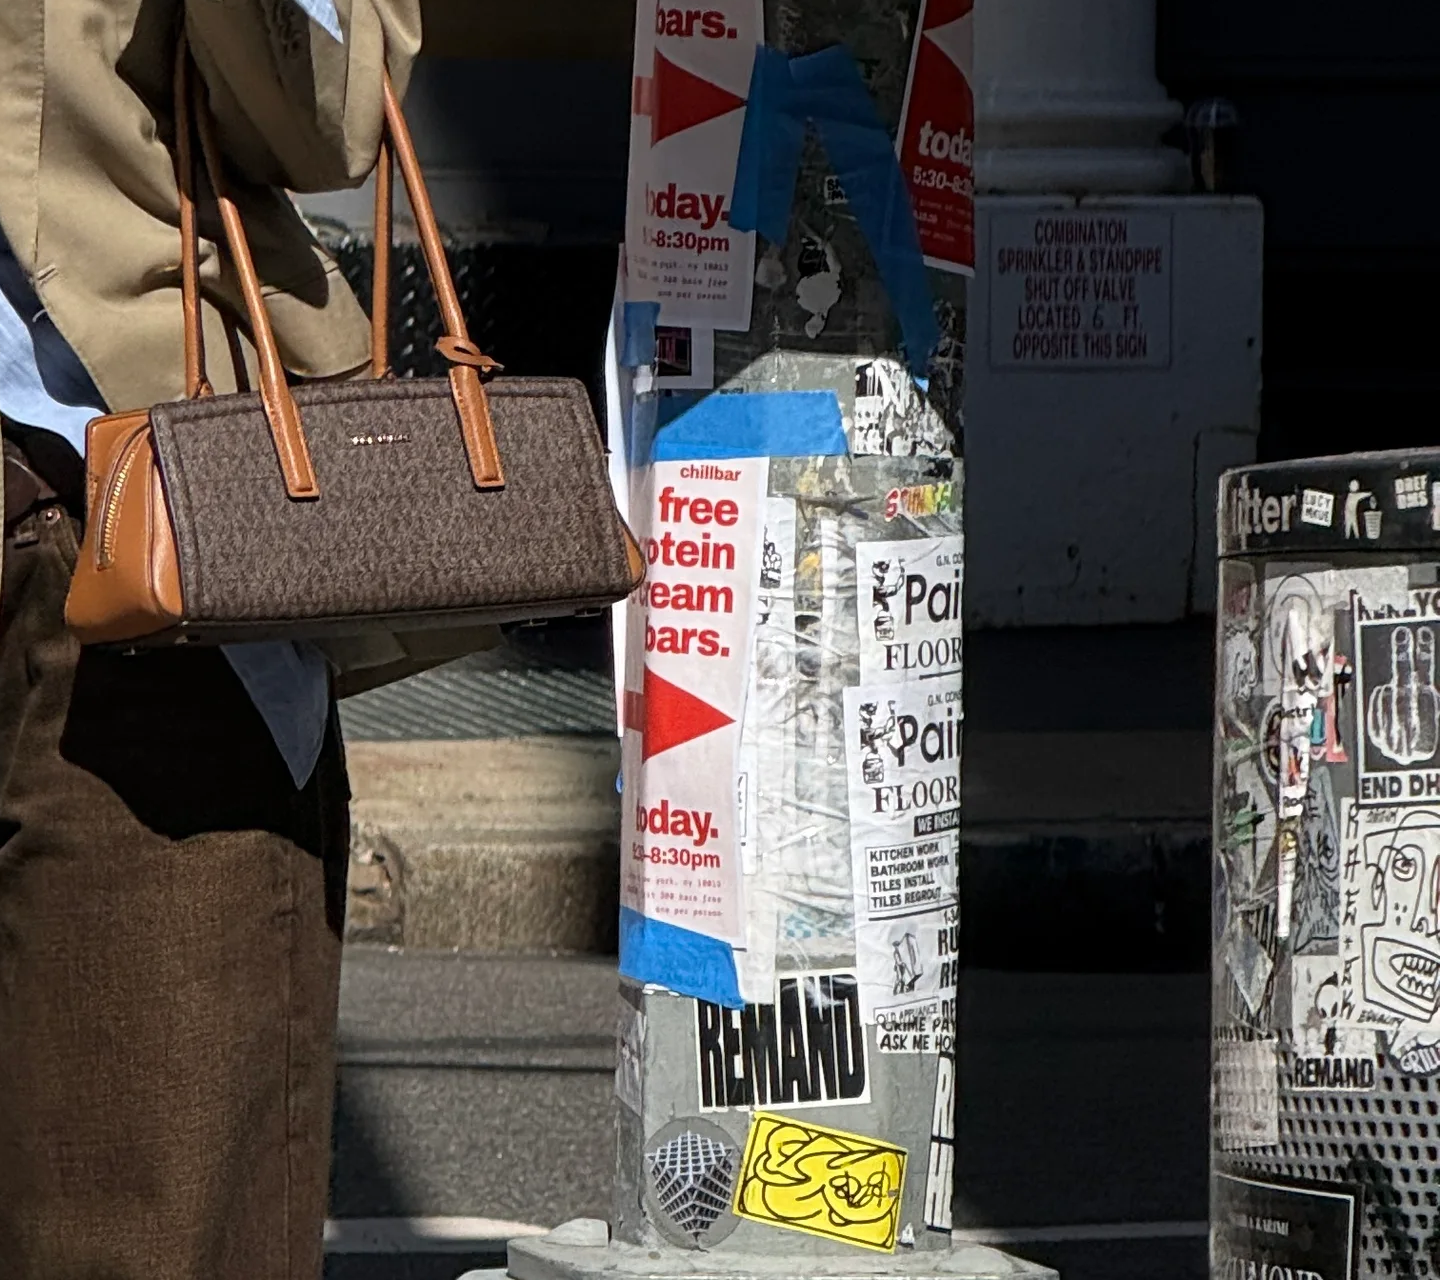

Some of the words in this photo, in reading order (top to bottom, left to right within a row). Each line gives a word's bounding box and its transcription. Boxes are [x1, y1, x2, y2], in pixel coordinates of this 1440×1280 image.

[1034, 219, 1127, 246] COMBINATION
[998, 247, 1072, 274] SPRINKLER
[1076, 248, 1086, 273] &
[1089, 247, 1162, 274] STANDPIPE
[1024, 275, 1060, 303] SHUT
[1063, 275, 1090, 301] OFF
[1093, 275, 1136, 301] VALVE
[1018, 305, 1080, 331] LOCATED
[1092, 305, 1104, 329] 6
[1123, 304, 1143, 330] FT.
[1013, 333, 1079, 360] OPPOSITE
[1083, 333, 1112, 358] THIS
[1116, 333, 1147, 359] SIGN
[680, 465, 742, 481] chillbar
[659, 486, 739, 526] free
[644, 532, 735, 570] otein
[905, 569, 960, 626] Pai
[645, 615, 730, 658] bars.
[883, 636, 962, 671] FLOOR
[872, 775, 958, 813] FLOOR
[1361, 776, 1403, 799] END
[917, 816, 934, 833] WE
[870, 846, 914, 862] KITCHEN
[917, 841, 940, 856] WORK
[870, 858, 924, 877] BATHROOM
[927, 854, 949, 869] WORK
[870, 878, 902, 893] TILES
[904, 873, 935, 890] INSTALL
[871, 893, 902, 909] TILES
[904, 886, 942, 904] REGROUT
[883, 1016, 927, 1033] CRIME
[698, 974, 866, 1107] REMAND
[879, 1034, 908, 1051] ASK
[912, 1034, 930, 1051] ME
[1294, 1057, 1375, 1088] REMAND
